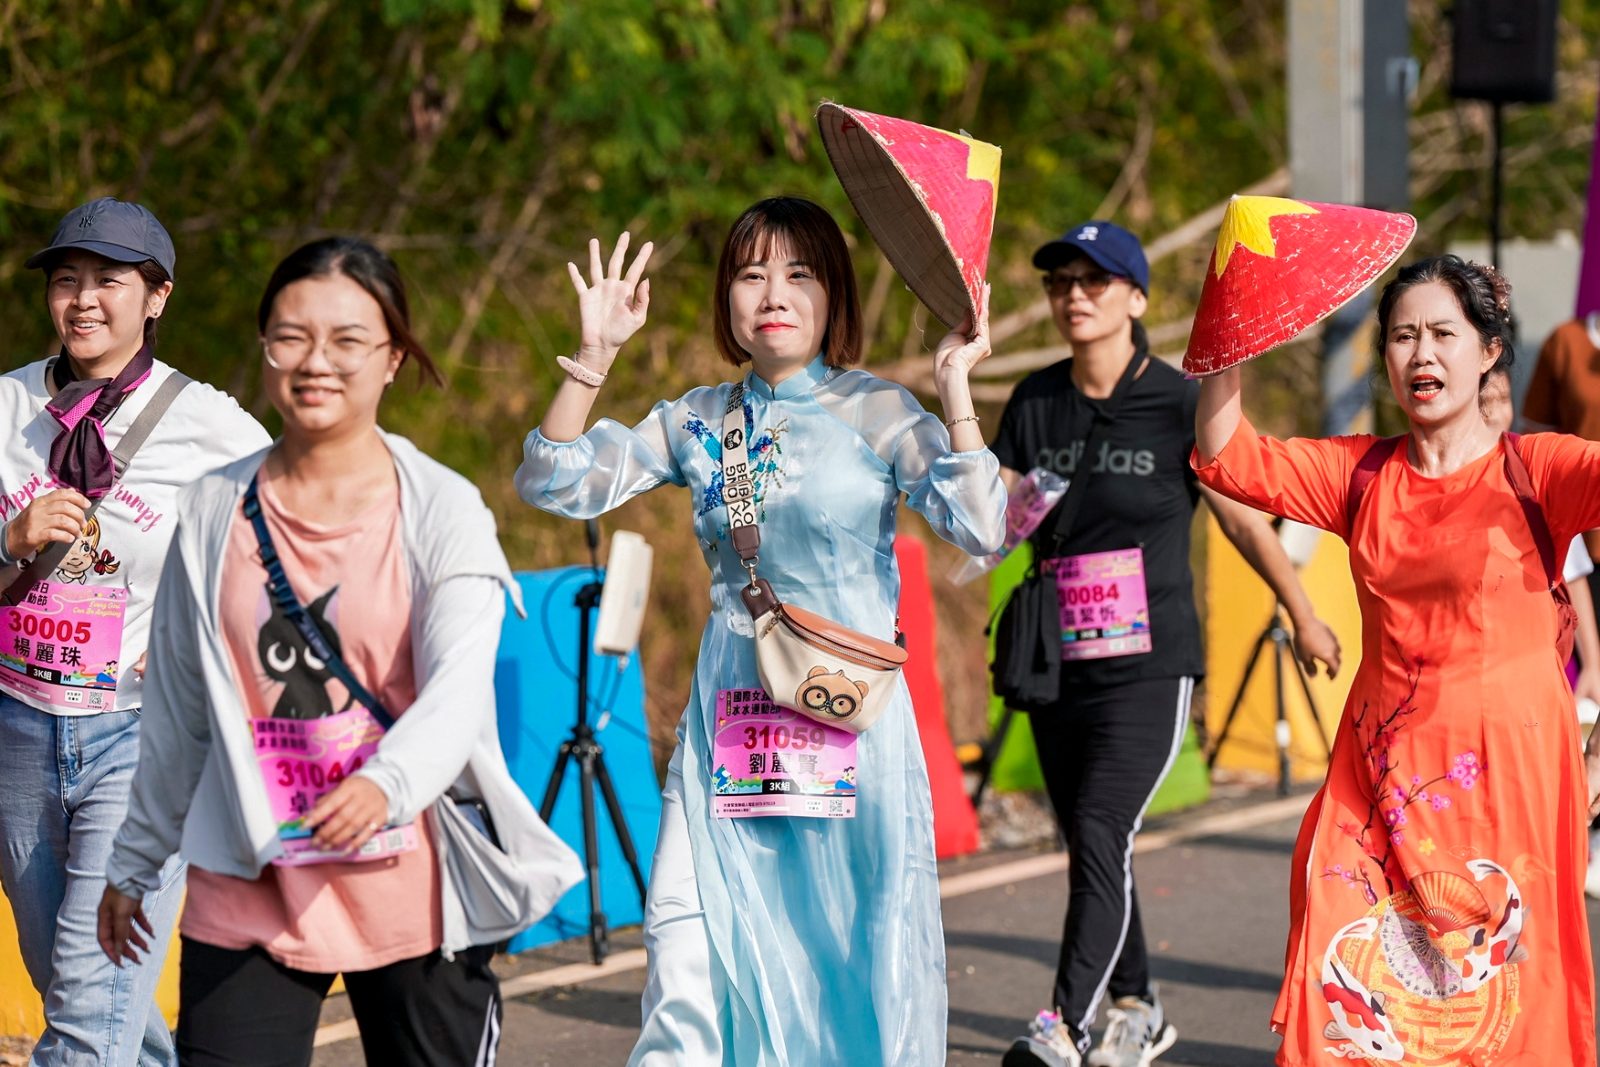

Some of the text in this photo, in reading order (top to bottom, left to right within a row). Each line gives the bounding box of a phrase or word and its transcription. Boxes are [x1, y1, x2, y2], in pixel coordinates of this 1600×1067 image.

[9, 610, 91, 644] 30005
[14, 636, 81, 667] 楊麗珠
[63, 674, 72, 682] M
[744, 725, 826, 750] 31059
[749, 752, 818, 775] 劉麗賢
[769, 781, 791, 792] 3K組
